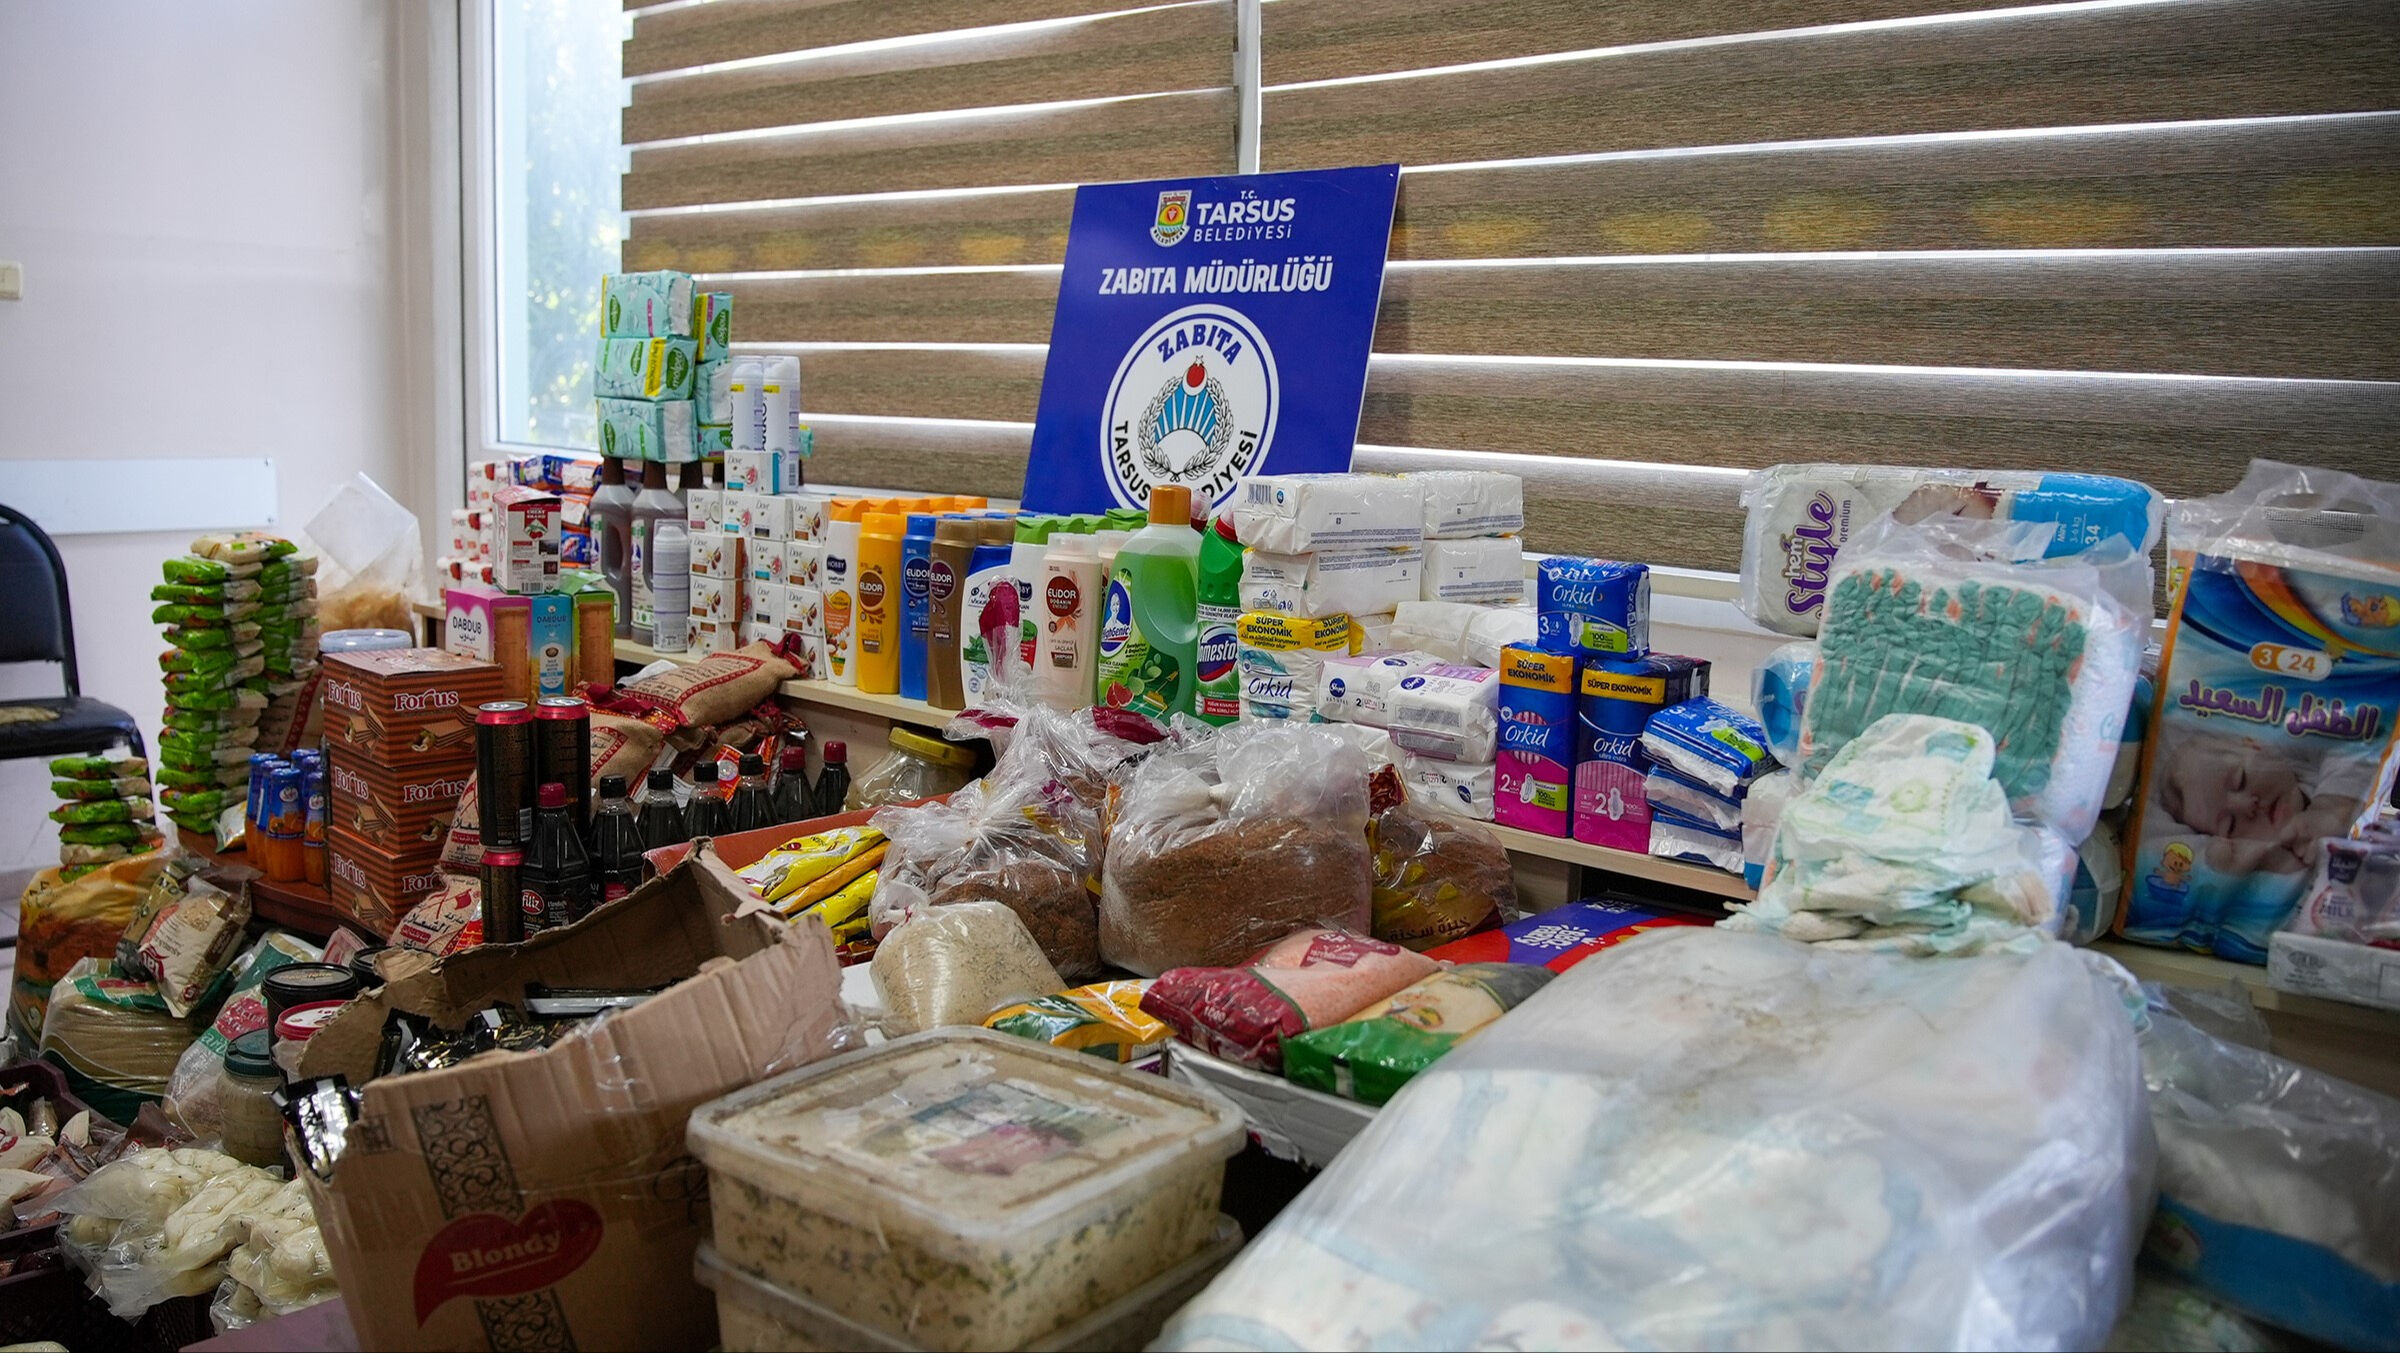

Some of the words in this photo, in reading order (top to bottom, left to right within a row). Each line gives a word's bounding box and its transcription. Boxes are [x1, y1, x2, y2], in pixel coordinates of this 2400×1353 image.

[1240, 190, 1258, 200] T.C.
[1197, 198, 1296, 225] TARSUS
[1193, 224, 1292, 243] BELEDİYESİ
[1098, 266, 1177, 295] ZABITA
[1183, 256, 1334, 294] MÜDÜRLÜĞÜ
[1157, 323, 1243, 366] ZABITA
[672, 350, 683, 389] molped
[1112, 420, 1152, 501] TARSUS
[1205, 430, 1258, 499] DİYESİ
[1840, 499, 1851, 543] premium
[2085, 524, 2101, 545] 34
[755, 545, 769, 553] Dove
[790, 549, 803, 557] Dove
[1786, 491, 1839, 615] Style
[789, 593, 803, 601] Dove
[1552, 584, 1598, 606] Orkid
[1246, 624, 1293, 638] EKONOMİK
[1540, 615, 1550, 635] 3
[1516, 659, 1546, 672] SÜPER
[2258, 649, 2274, 665] 3
[2287, 653, 2316, 673] 24
[1507, 669, 1556, 684] EKONOMİK
[1587, 679, 1610, 691] SÜPER
[1611, 683, 1653, 696] EKONOMİK
[1248, 677, 1294, 700] Orkid
[1355, 698, 1362, 708] 2
[2178, 679, 2284, 724] السعيد
[2285, 694, 2380, 744] الطفل
[1505, 725, 1551, 749] Orkid
[1593, 737, 1637, 758] Orkid
[1500, 774, 1511, 793] 2
[1594, 793, 1608, 815] 2
[450, 1229, 561, 1274] Blondy
